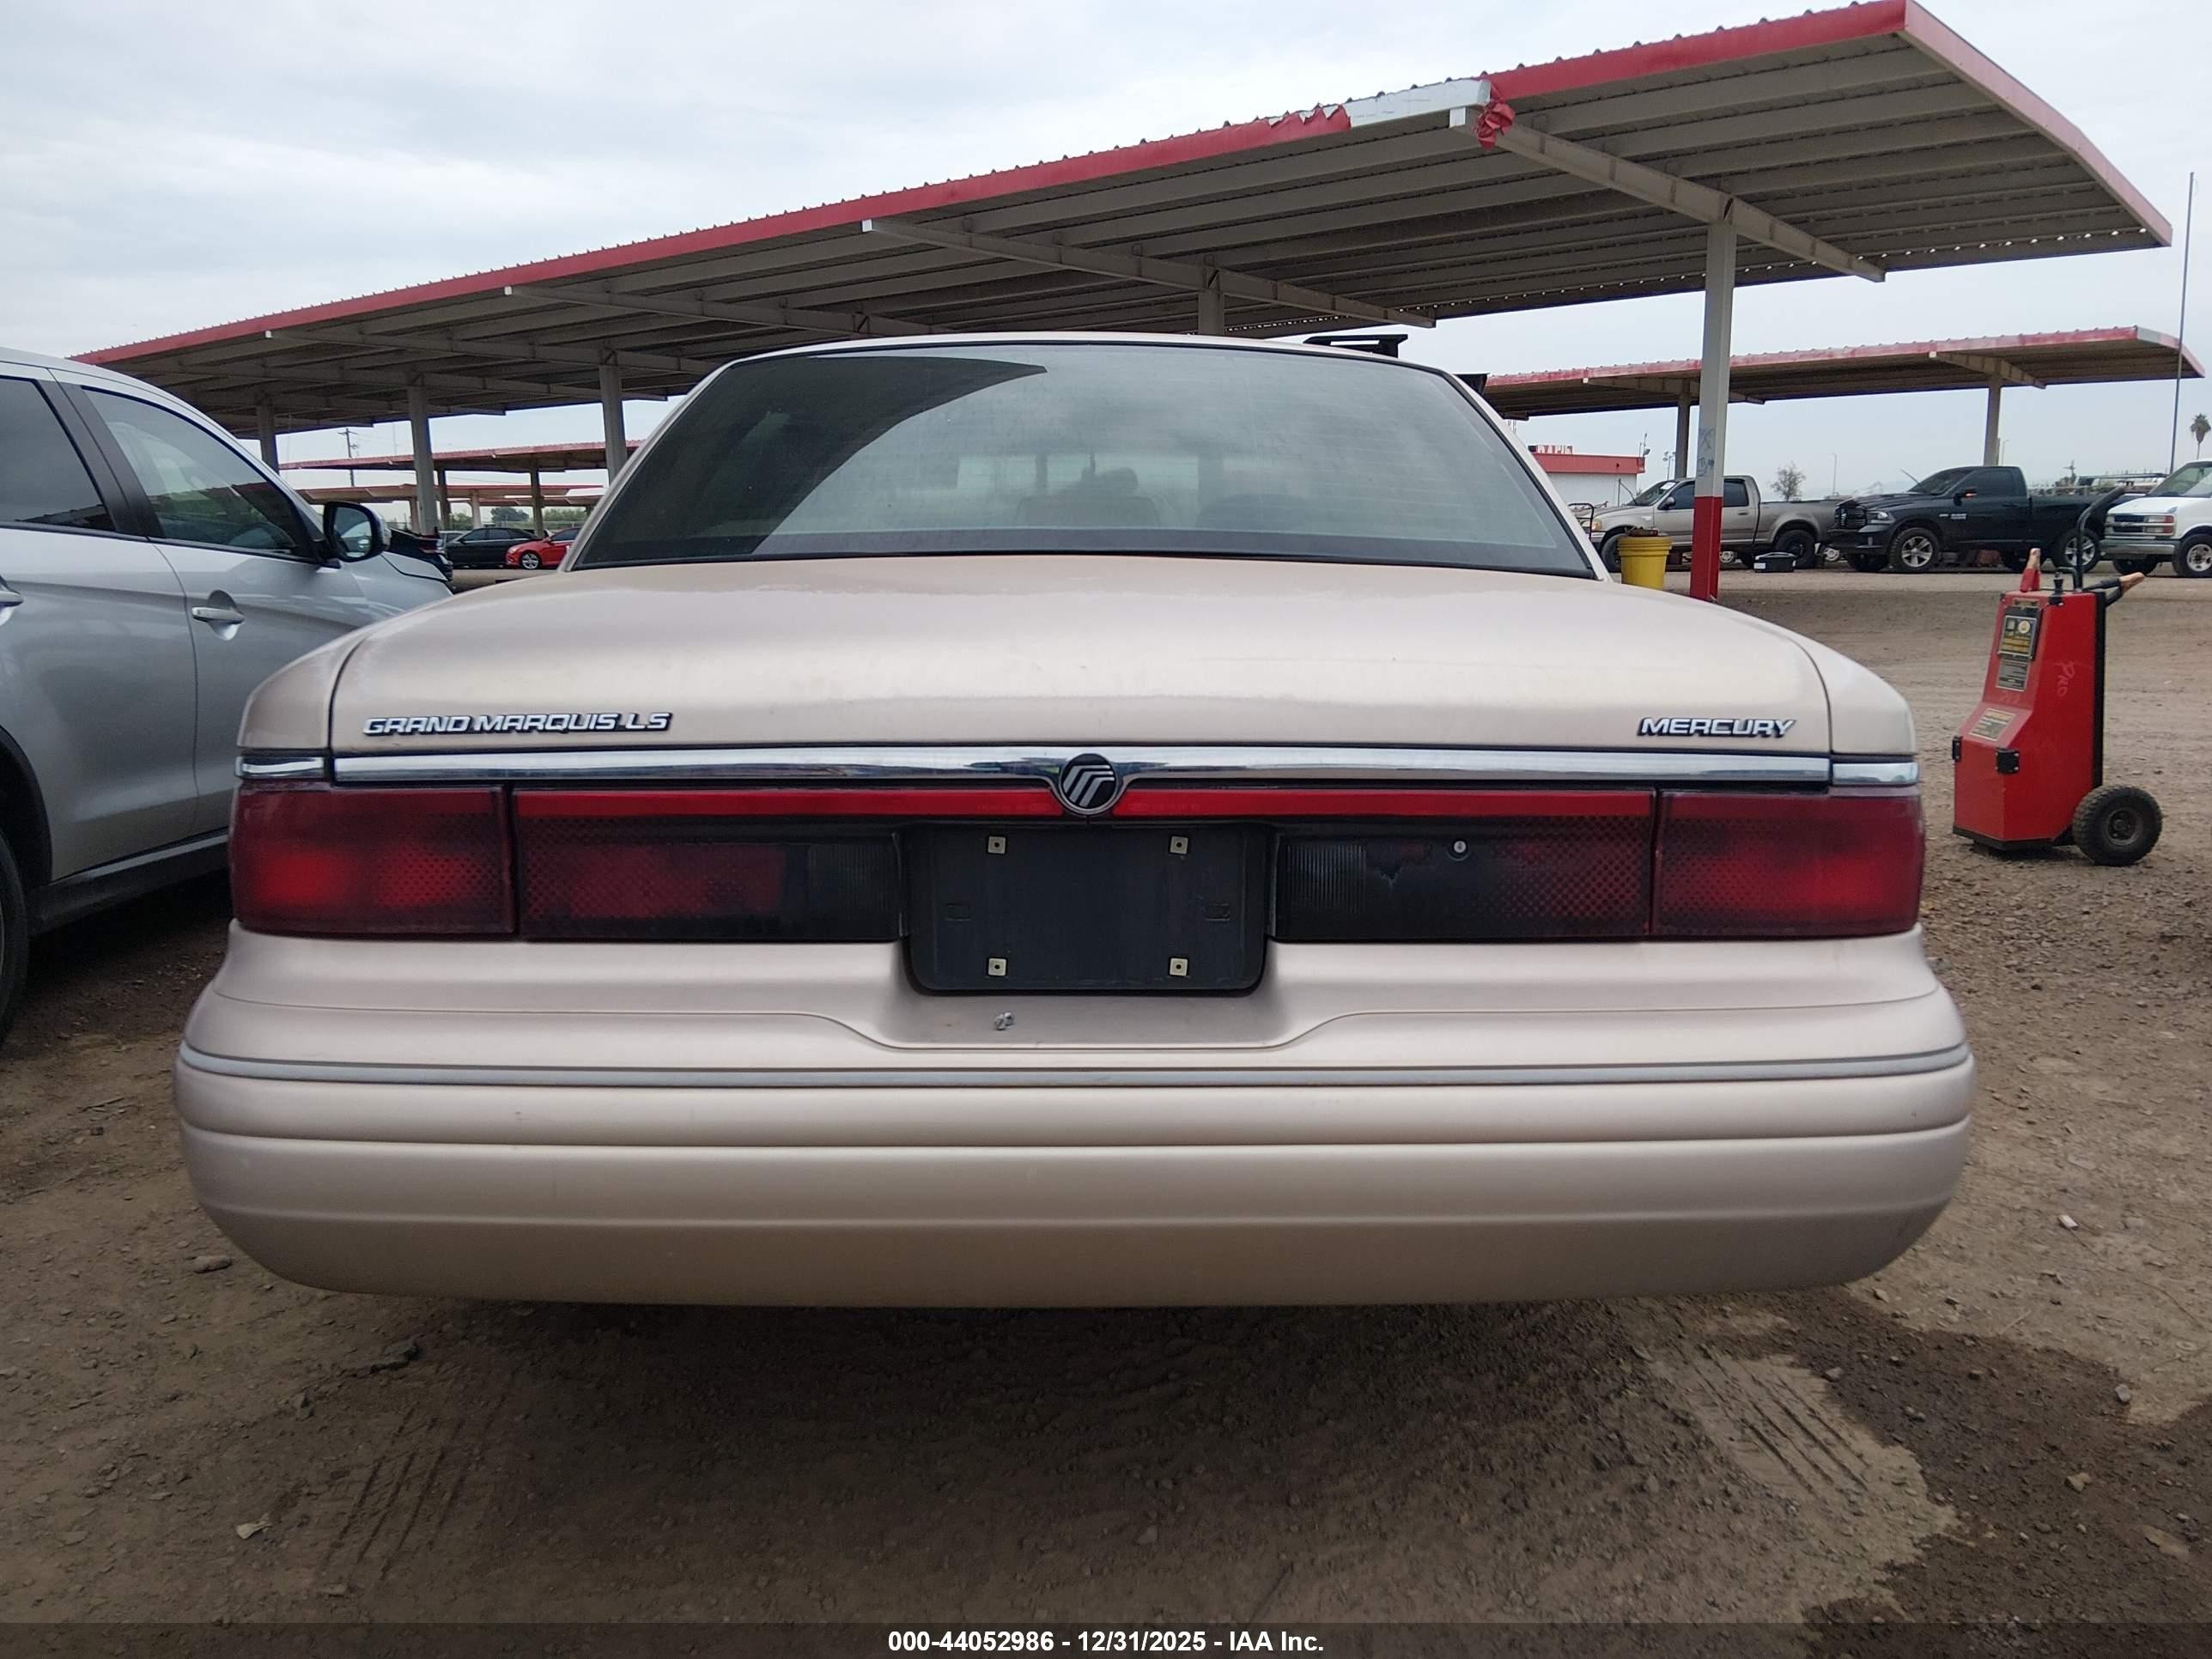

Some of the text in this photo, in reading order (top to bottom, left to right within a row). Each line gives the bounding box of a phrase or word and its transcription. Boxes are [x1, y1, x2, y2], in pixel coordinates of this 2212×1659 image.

[362, 712, 673, 736] GRAND MARQUIS LS
[1637, 716, 1796, 738] MERCURY
